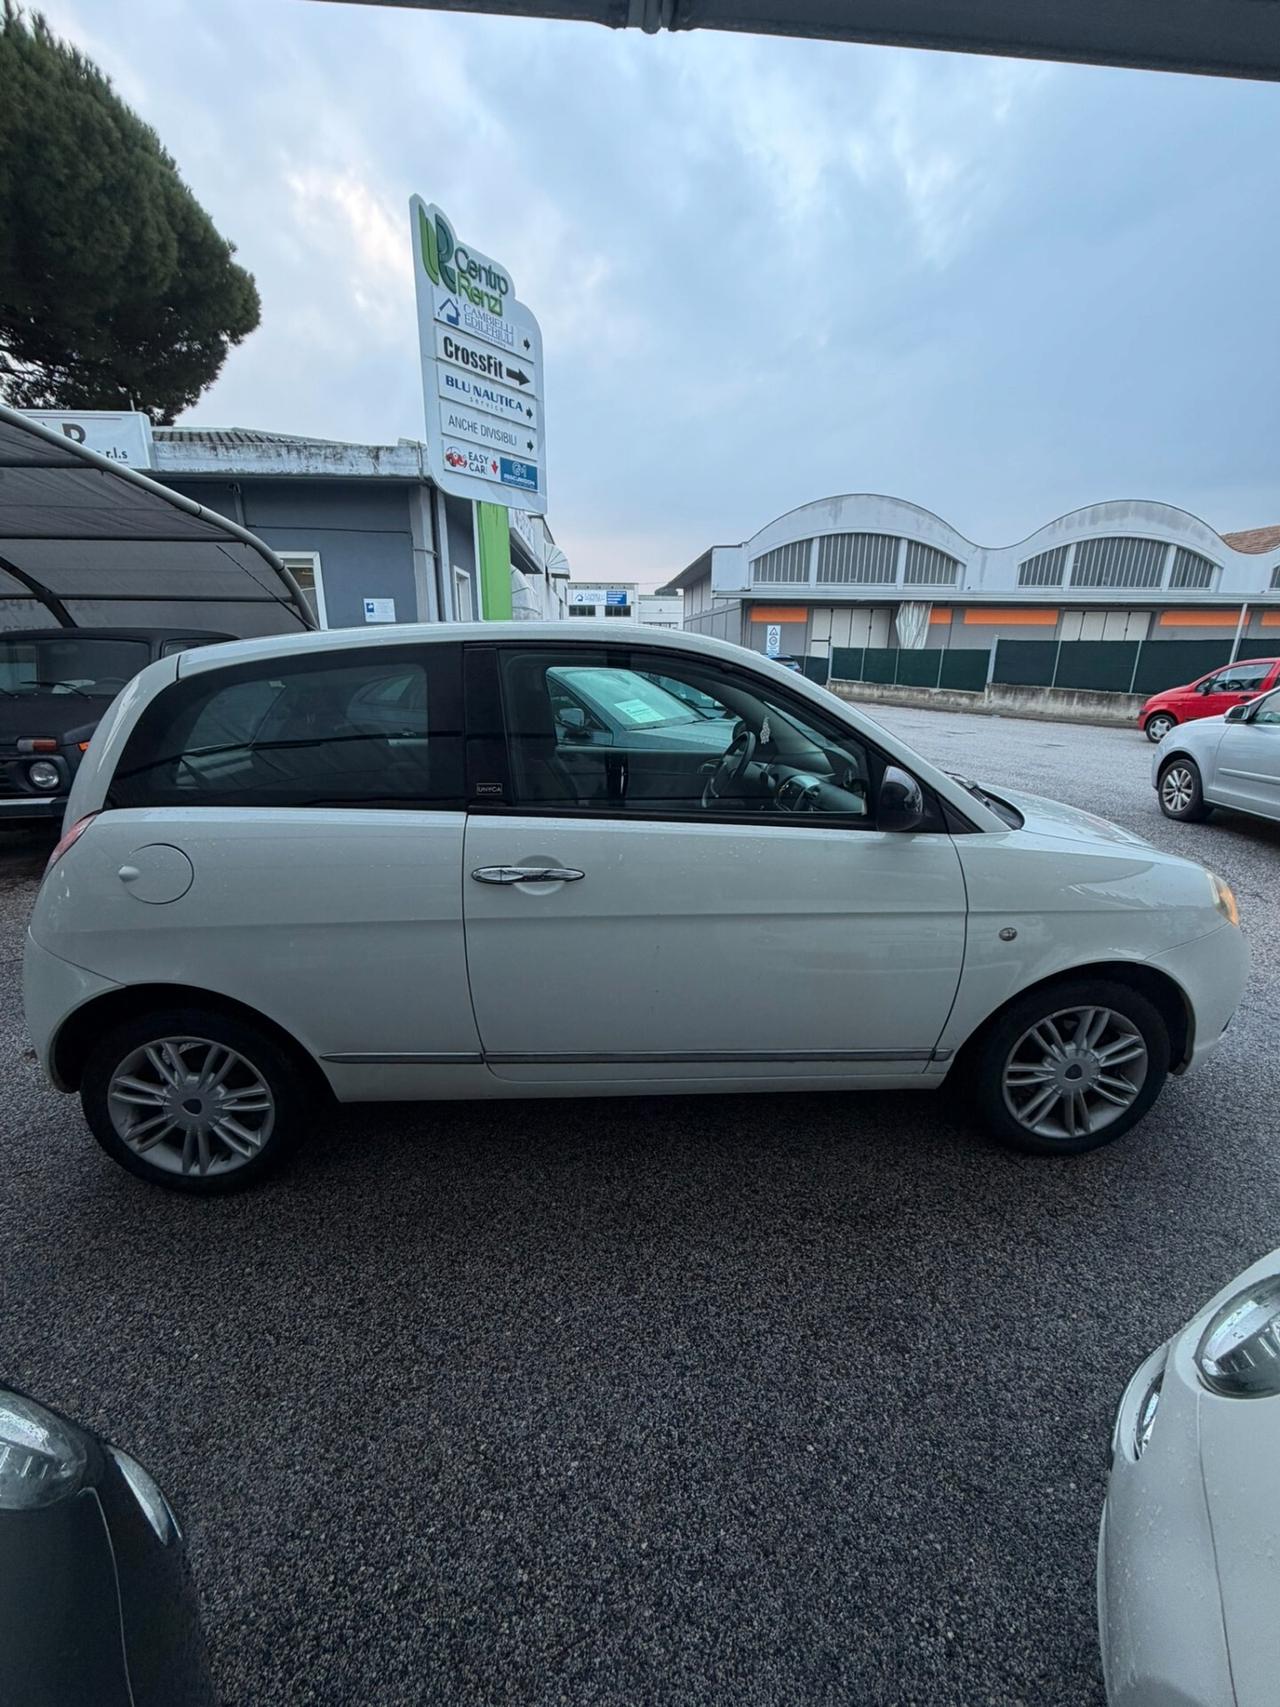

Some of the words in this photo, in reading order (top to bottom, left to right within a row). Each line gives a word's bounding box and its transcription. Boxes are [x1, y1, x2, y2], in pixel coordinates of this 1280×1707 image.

[455, 247, 509, 296] Centro
[457, 272, 503, 317] Renzi
[443, 336, 504, 379] CrossFit
[445, 375, 471, 393] BLU
[473, 385, 523, 412] NAUTICA
[449, 414, 479, 434] ANCHE
[480, 424, 517, 446] DIVISIBILI
[468, 451, 489, 465] EASY
[468, 462, 487, 475] CAR
